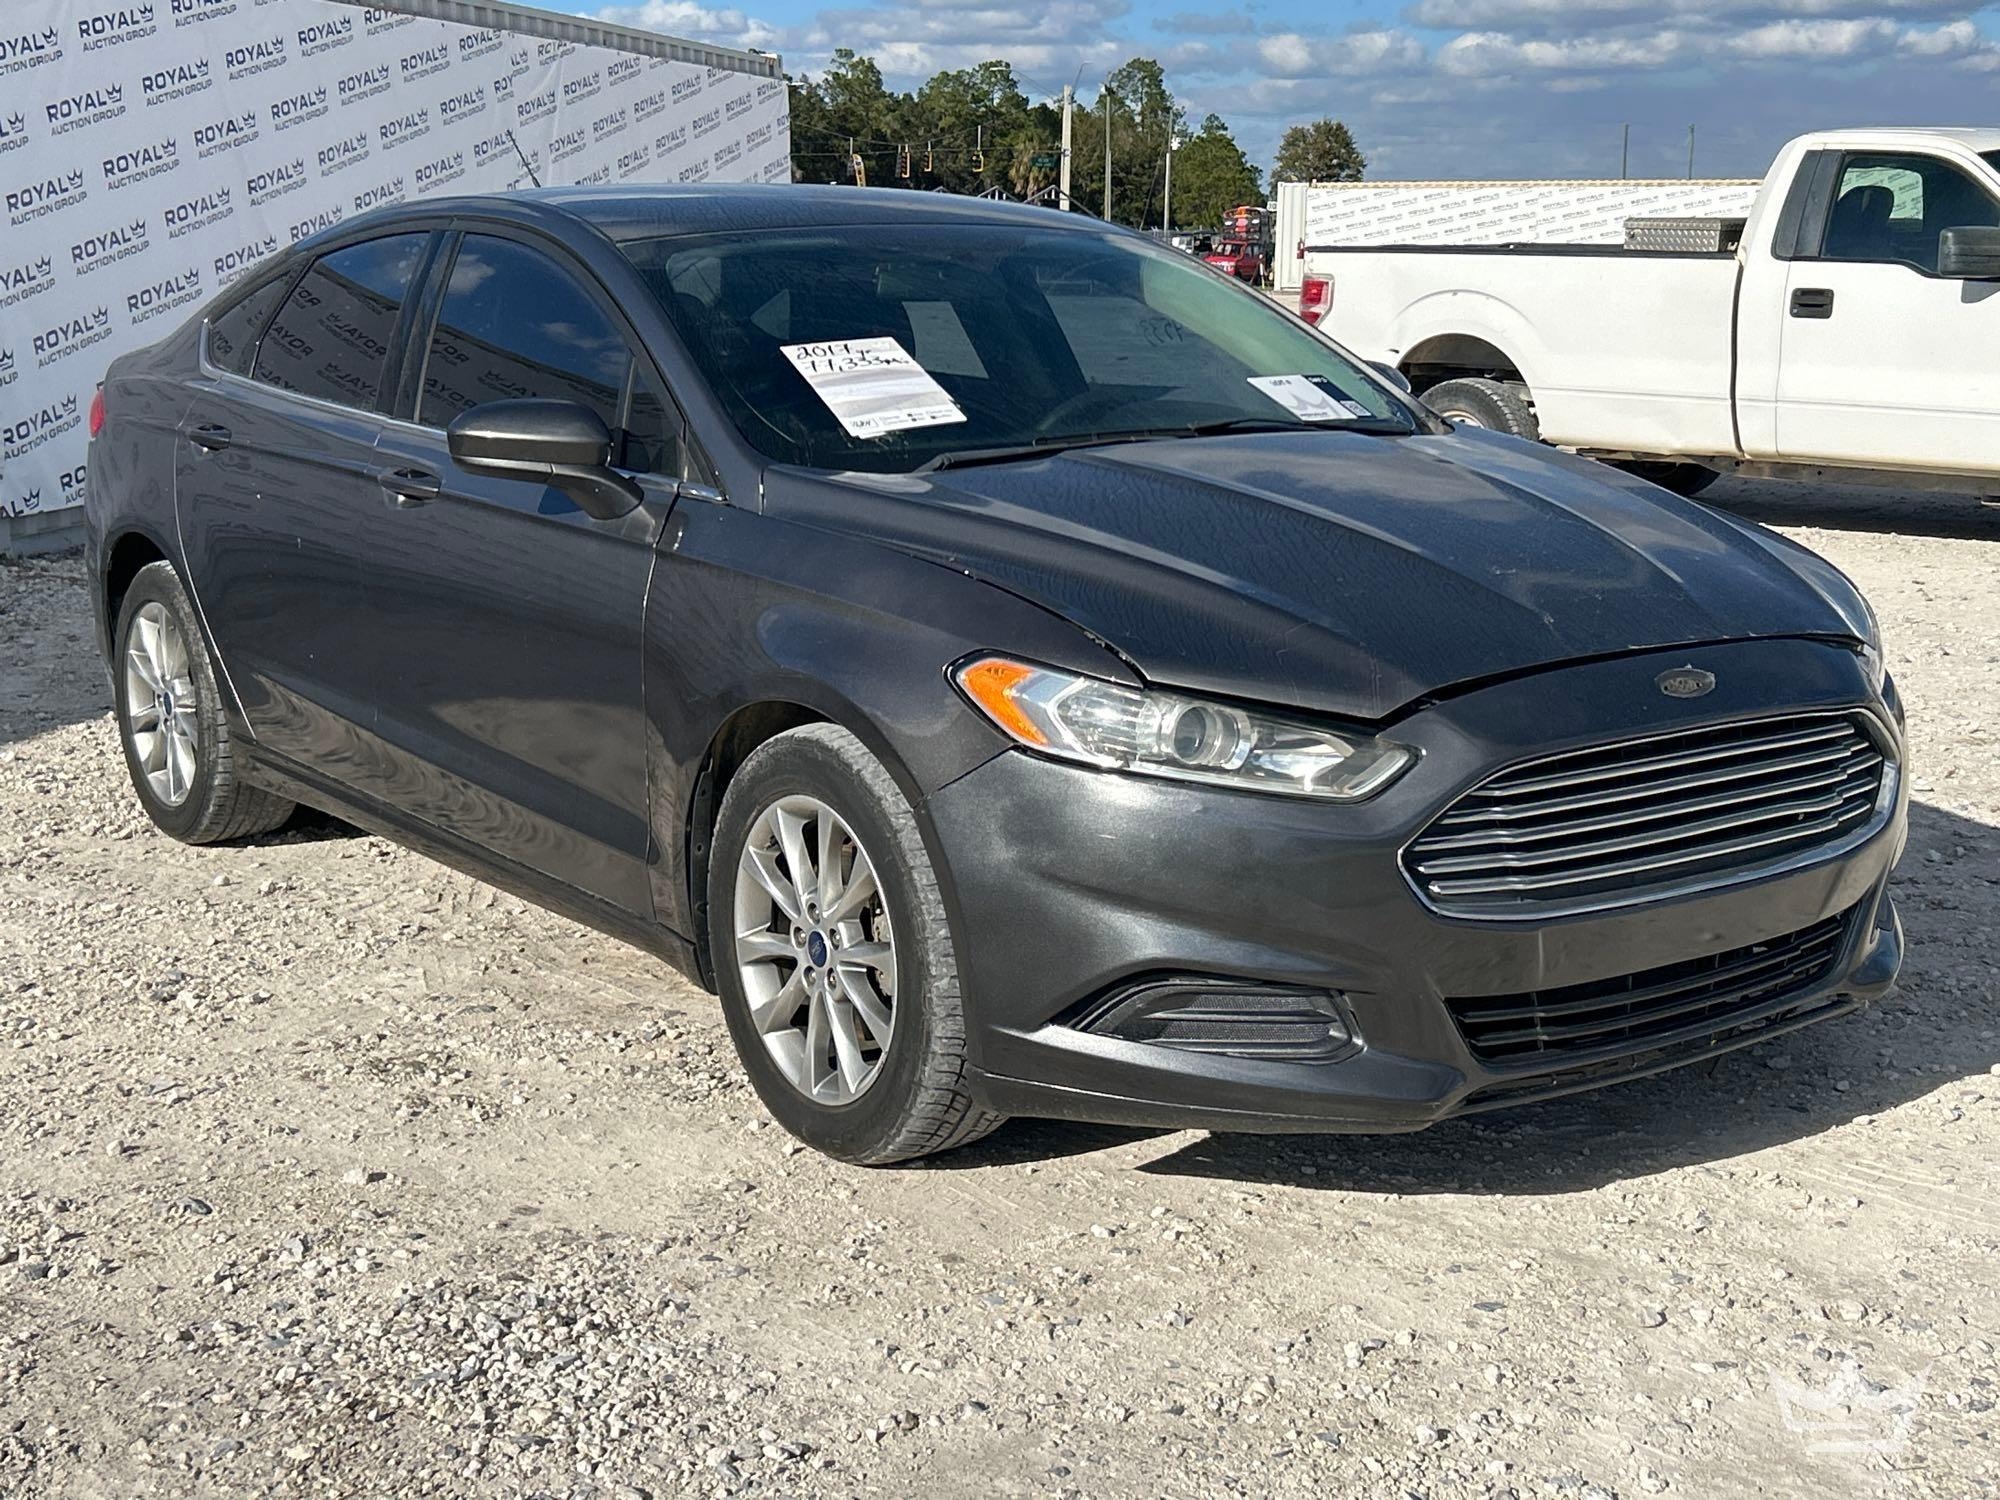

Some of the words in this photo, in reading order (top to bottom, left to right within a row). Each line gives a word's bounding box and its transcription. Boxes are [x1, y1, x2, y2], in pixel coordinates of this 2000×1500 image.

[79, 9, 140, 39] ROYAL
[364, 9, 399, 25] ROY
[0, 33, 45, 61] OYAL
[82, 33, 125, 53] AUCTION
[125, 25, 157, 42] GROUP
[297, 20, 342, 46] ROYAL
[459, 30, 493, 53] ROYAL
[0, 60, 28, 76] CTION
[28, 49, 63, 68] GROUP
[226, 42, 273, 69] ROYAL
[229, 64, 262, 81] AUCTION
[262, 56, 287, 71] GROUP
[400, 48, 439, 73] ROYAL
[607, 58, 634, 79] ROYAL
[142, 63, 197, 94] ROYAL
[338, 71, 380, 95] ROYAL
[564, 76, 593, 96] ROYAL
[671, 77, 696, 97] ROYAL
[46, 90, 107, 123] ROYAL
[146, 89, 185, 107] AUCTION
[185, 79, 213, 96] GROUP
[271, 92, 316, 120] ROYAL
[440, 92, 476, 116] ROYAL
[517, 95, 546, 119] ROYAL
[633, 94, 659, 115] ROYAL
[725, 97, 747, 114] ROYAL
[51, 109, 91, 137] AUCTION
[92, 105, 126, 124] GROUP
[194, 120, 244, 148] ROYAL
[274, 114, 305, 132] AUCTION
[379, 113, 419, 141] ROYAL
[593, 113, 620, 135] ROYAL
[692, 112, 716, 133] ROYAL
[0, 136, 29, 154] ROUP
[198, 141, 232, 160] AUCTION
[318, 136, 358, 167] ROYAL
[474, 132, 506, 158] ROYAL
[655, 130, 680, 151] ROYAL
[714, 144, 736, 164] ROYAL
[103, 145, 163, 178] ROYAL
[415, 159, 454, 184] ROYAL
[617, 149, 644, 171] ROYAL
[678, 163, 703, 183] ROYAL
[107, 169, 149, 191] AUCTION
[149, 159, 181, 177] GROUP
[247, 165, 293, 195] ROYAL
[5, 177, 69, 213] ROYAL
[354, 182, 394, 211] ROYAL
[10, 204, 54, 228] AUCTION
[54, 191, 88, 211] GROUP
[165, 193, 218, 227] ROYAL
[169, 219, 205, 239] AUCTION
[205, 206, 234, 227] GROUP
[290, 211, 334, 242] ROYAL
[71, 227, 131, 264] ROYAL
[76, 254, 117, 278] AUCTION
[117, 239, 150, 261] GROUP
[214, 242, 264, 275] ROYAL
[0, 265, 37, 291] YAL
[0, 291, 20, 309] TION
[21, 277, 56, 300] GROUP
[126, 275, 185, 313] ROYAL
[131, 303, 172, 326] AUCTION
[171, 288, 204, 309] GROUP
[33, 315, 94, 355] ROYAL
[38, 343, 81, 370] AUCTION
[80, 327, 113, 351] GROUP
[3, 405, 64, 447] ROYAL
[4, 433, 48, 462] AUCTION
[49, 414, 82, 439] GROUP
